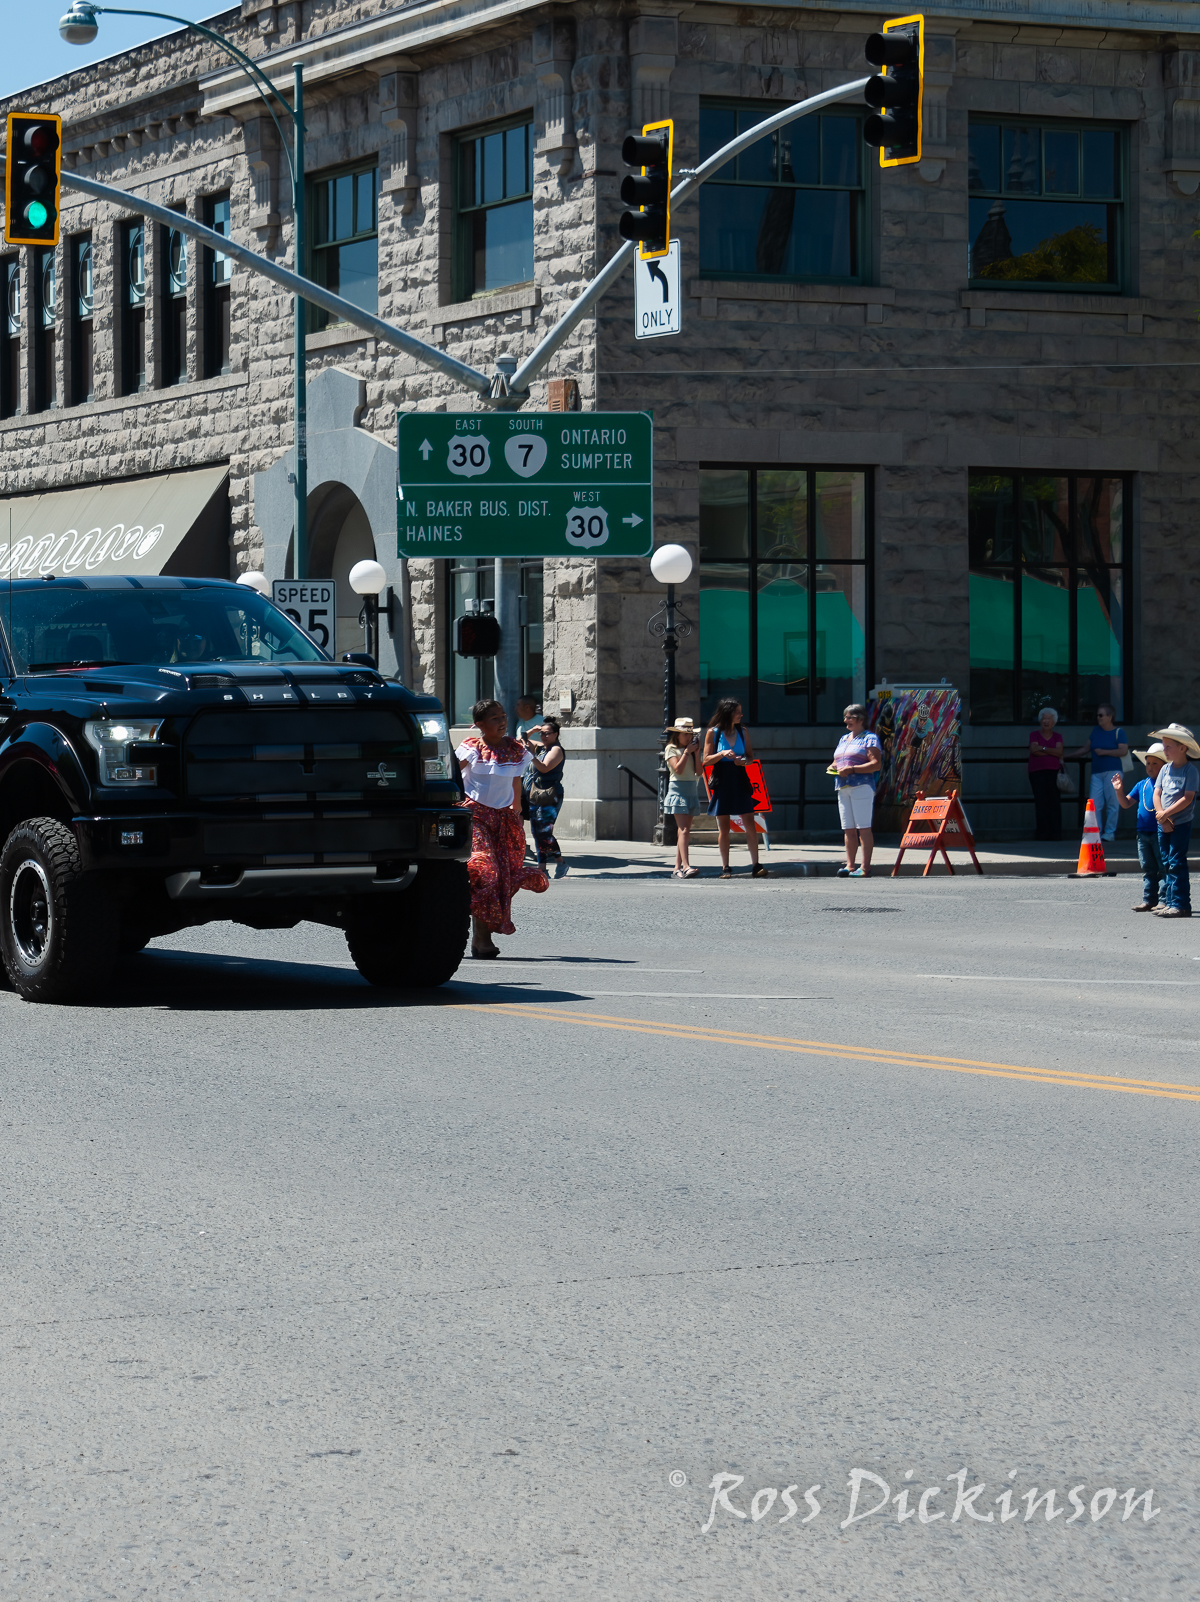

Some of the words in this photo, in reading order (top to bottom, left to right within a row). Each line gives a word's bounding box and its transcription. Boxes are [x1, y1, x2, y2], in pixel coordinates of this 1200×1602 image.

[642, 308, 673, 329] ONLY
[455, 419, 482, 430] EAST
[508, 419, 543, 430] SOUTH
[561, 429, 627, 445] ONTARIO
[451, 443, 485, 468] 30
[517, 444, 534, 468] 7
[560, 453, 632, 469] SUMPTER
[573, 491, 601, 502] WEST
[406, 501, 419, 517] N.
[427, 500, 472, 517] BAKER
[480, 500, 510, 517] BUS.
[518, 500, 551, 517] DIST.
[406, 525, 463, 541] HAINES
[570, 515, 603, 539] 30
[278, 588, 330, 603] SPEED
[223, 692, 373, 701] SHELBY
[912, 805, 933, 814] BAKER
[933, 804, 947, 813] CITY
[903, 835, 937, 846] CAUTION
